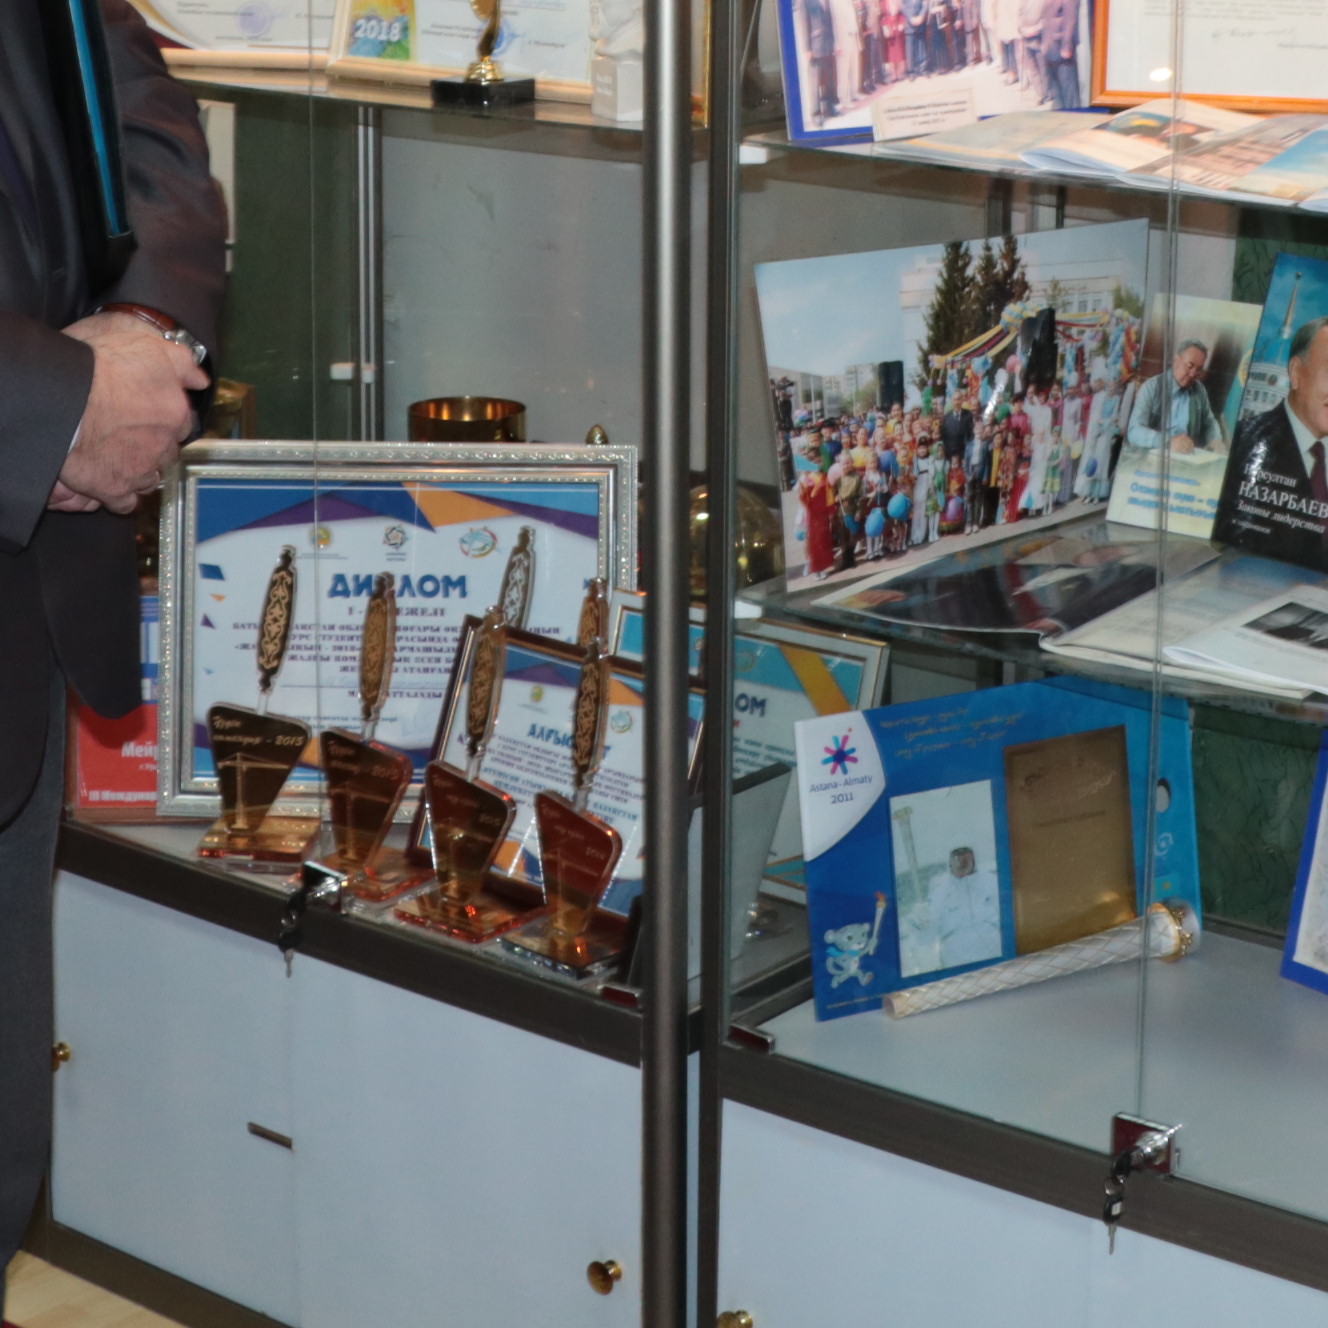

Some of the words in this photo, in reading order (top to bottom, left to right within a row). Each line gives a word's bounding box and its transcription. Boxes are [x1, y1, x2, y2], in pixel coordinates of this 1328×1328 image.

[354, 17, 403, 43] 2018
[1236, 499, 1270, 519] Законы
[1270, 512, 1327, 534] лидерства
[327, 573, 469, 599] ДИЛОМ
[830, 791, 855, 805] 2011
